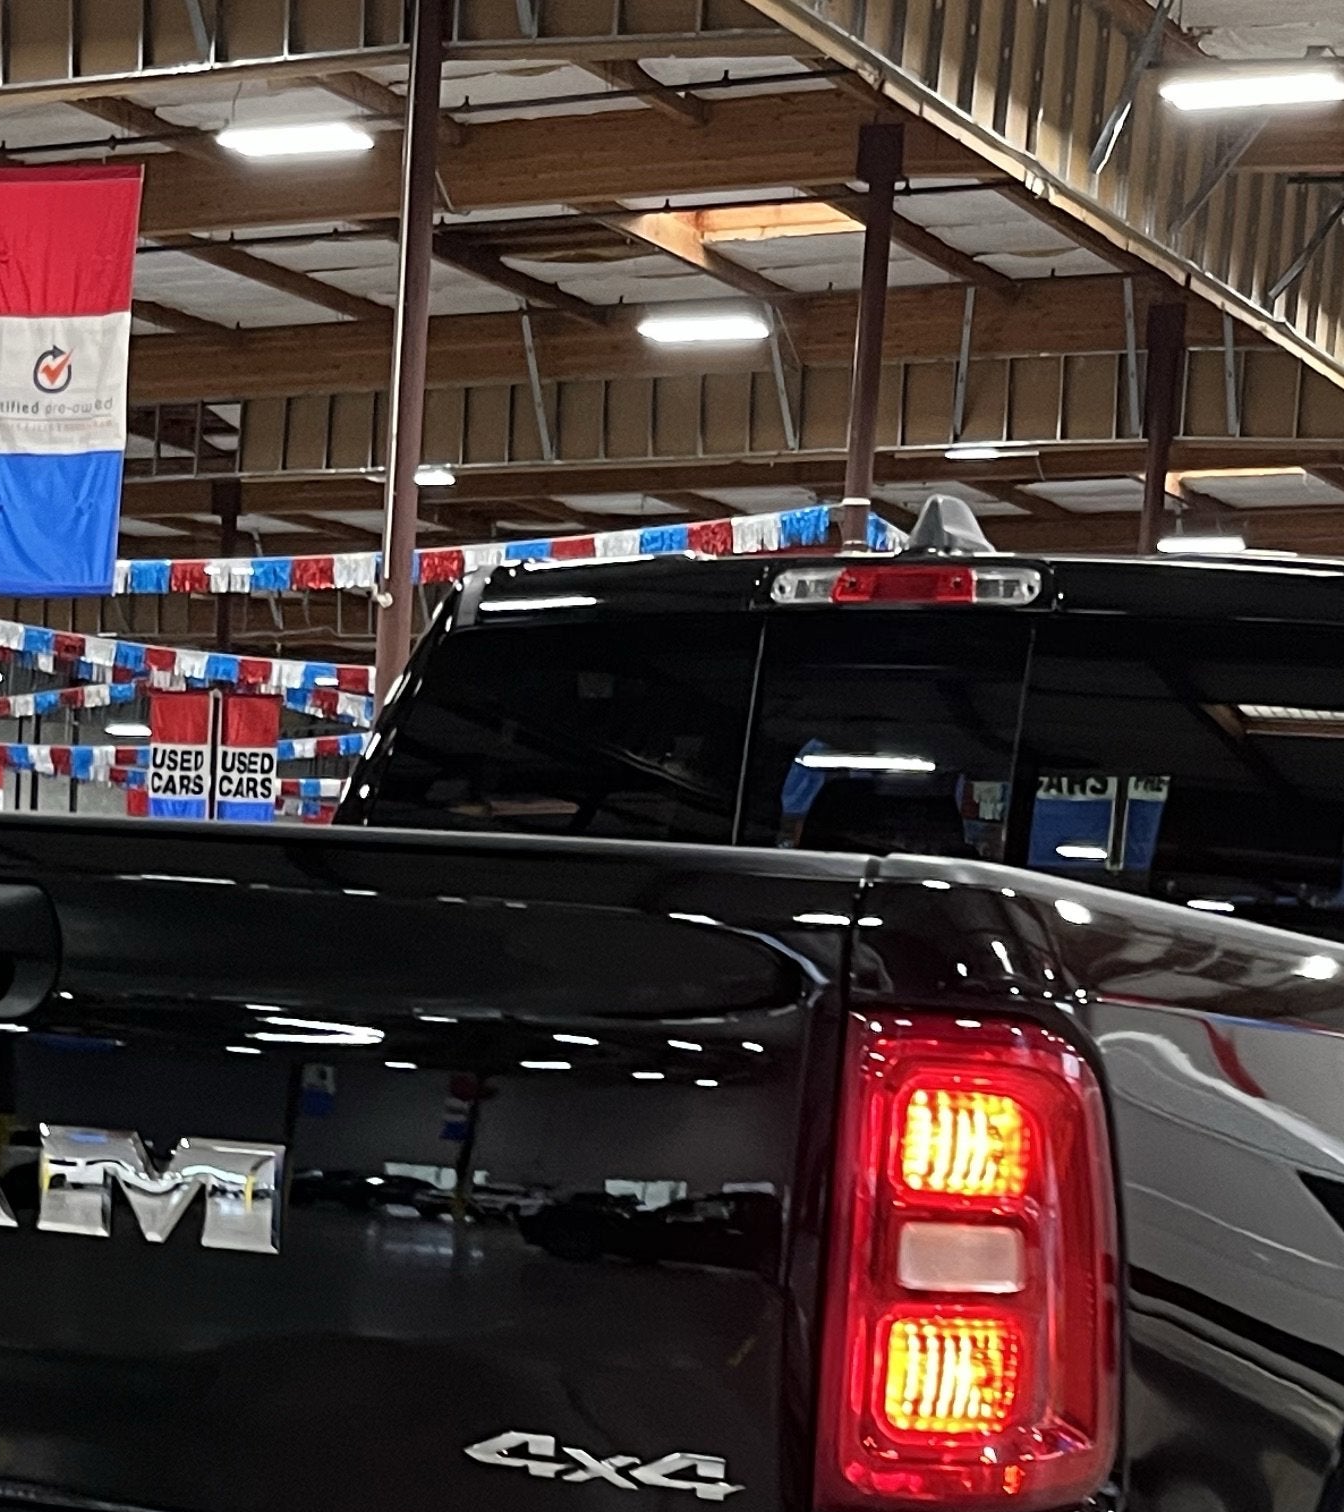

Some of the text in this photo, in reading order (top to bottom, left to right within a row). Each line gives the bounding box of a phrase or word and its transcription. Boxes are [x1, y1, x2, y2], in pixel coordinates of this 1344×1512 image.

[153, 748, 204, 771] USED
[221, 751, 274, 774] USED
[151, 772, 204, 795] CARS
[219, 775, 272, 799] CARS
